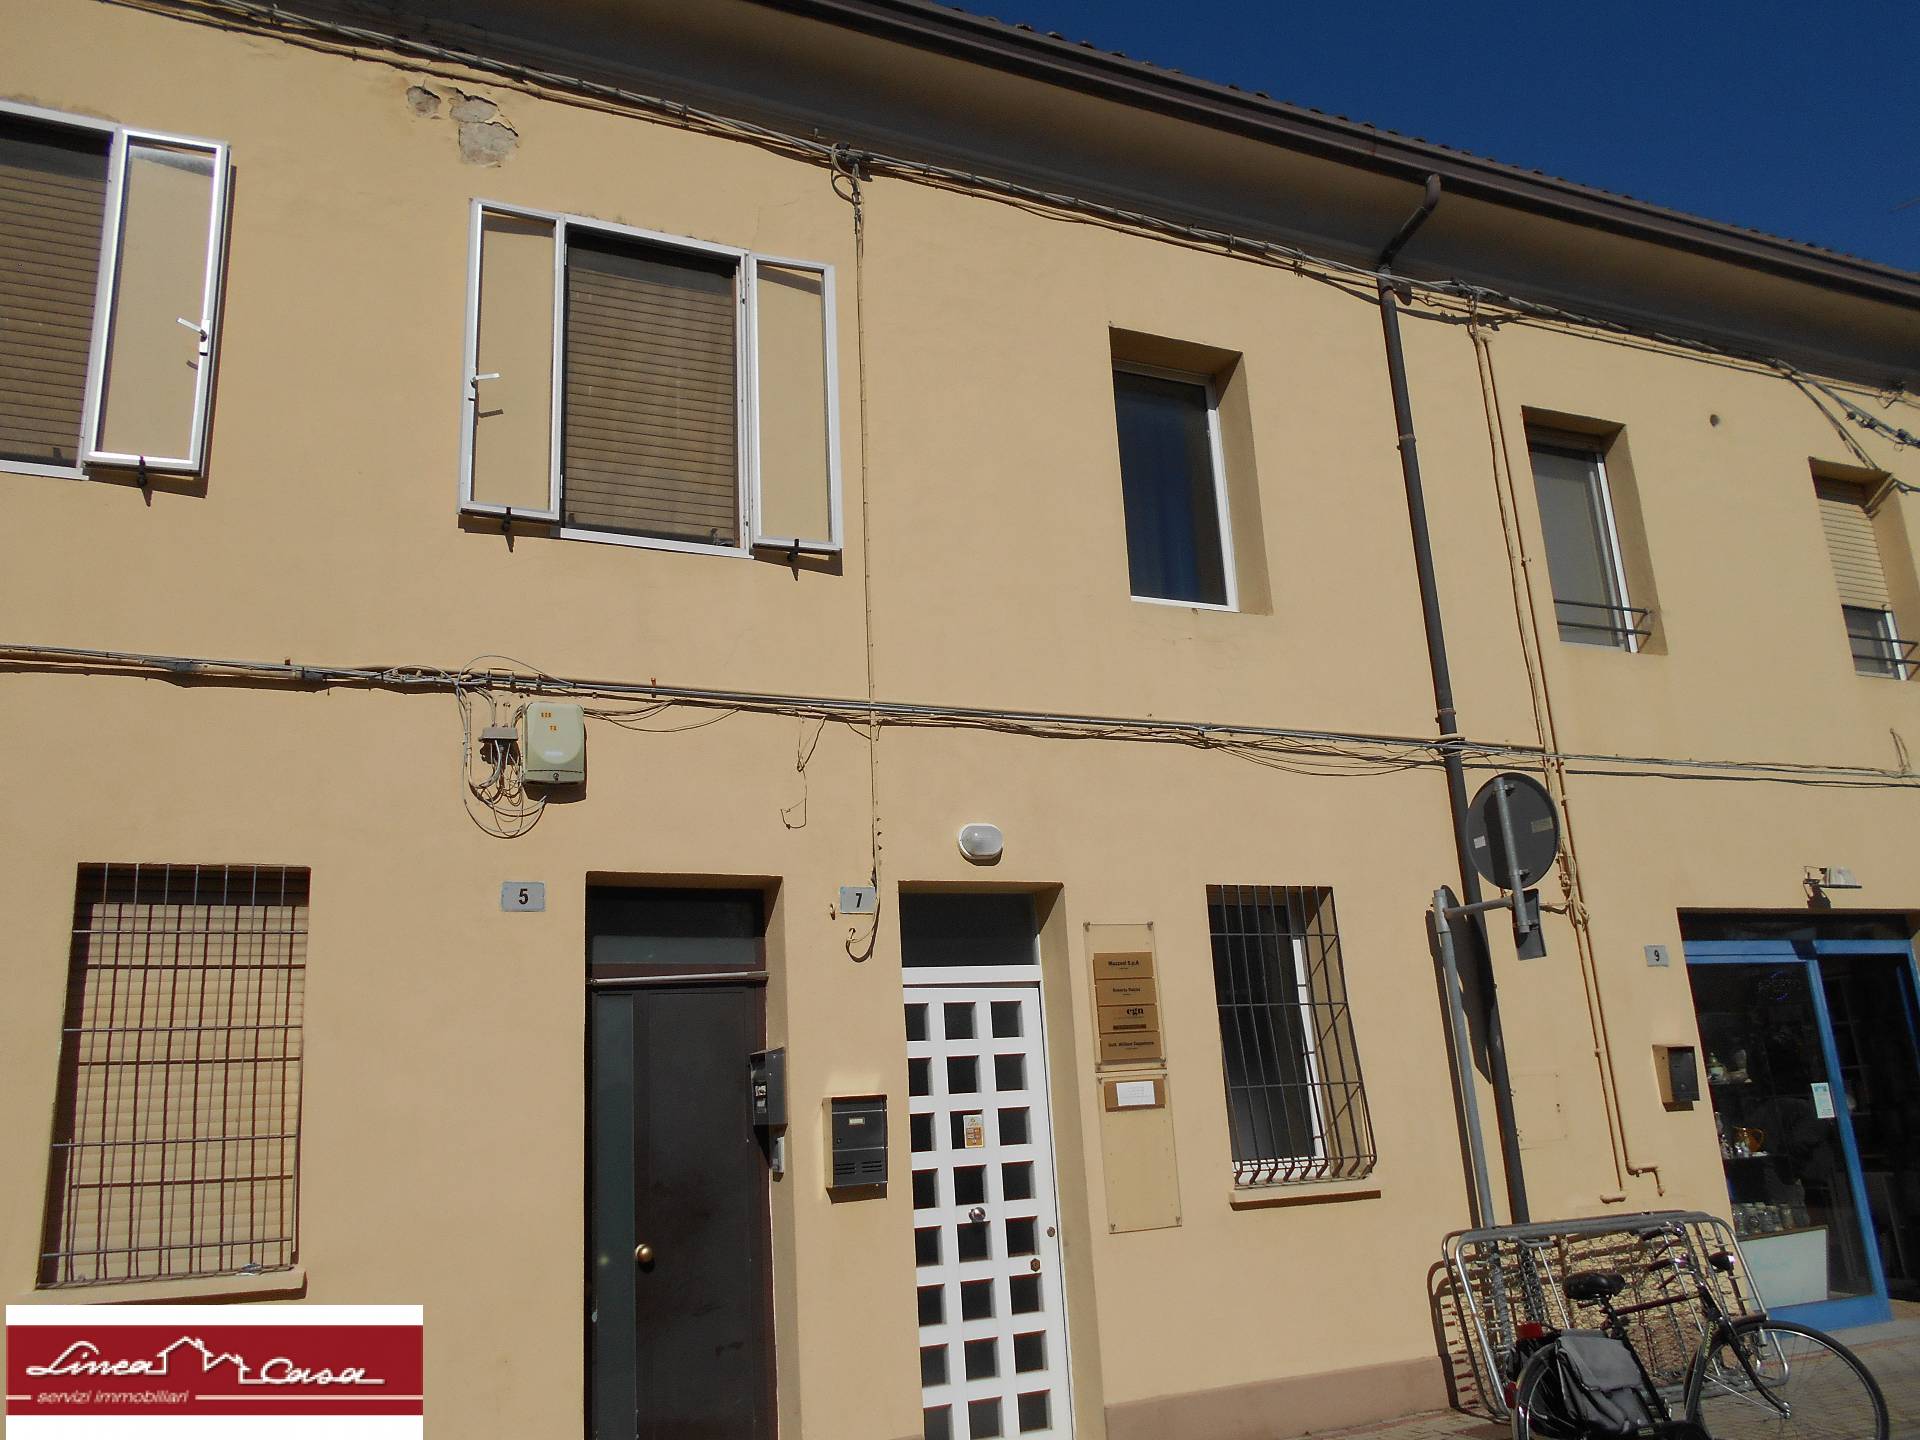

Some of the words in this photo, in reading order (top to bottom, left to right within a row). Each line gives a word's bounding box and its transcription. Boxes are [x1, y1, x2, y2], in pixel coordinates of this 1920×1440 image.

[519, 888, 528, 905] 5
[855, 892, 862, 908] 7
[1654, 949, 1660, 962] 9
